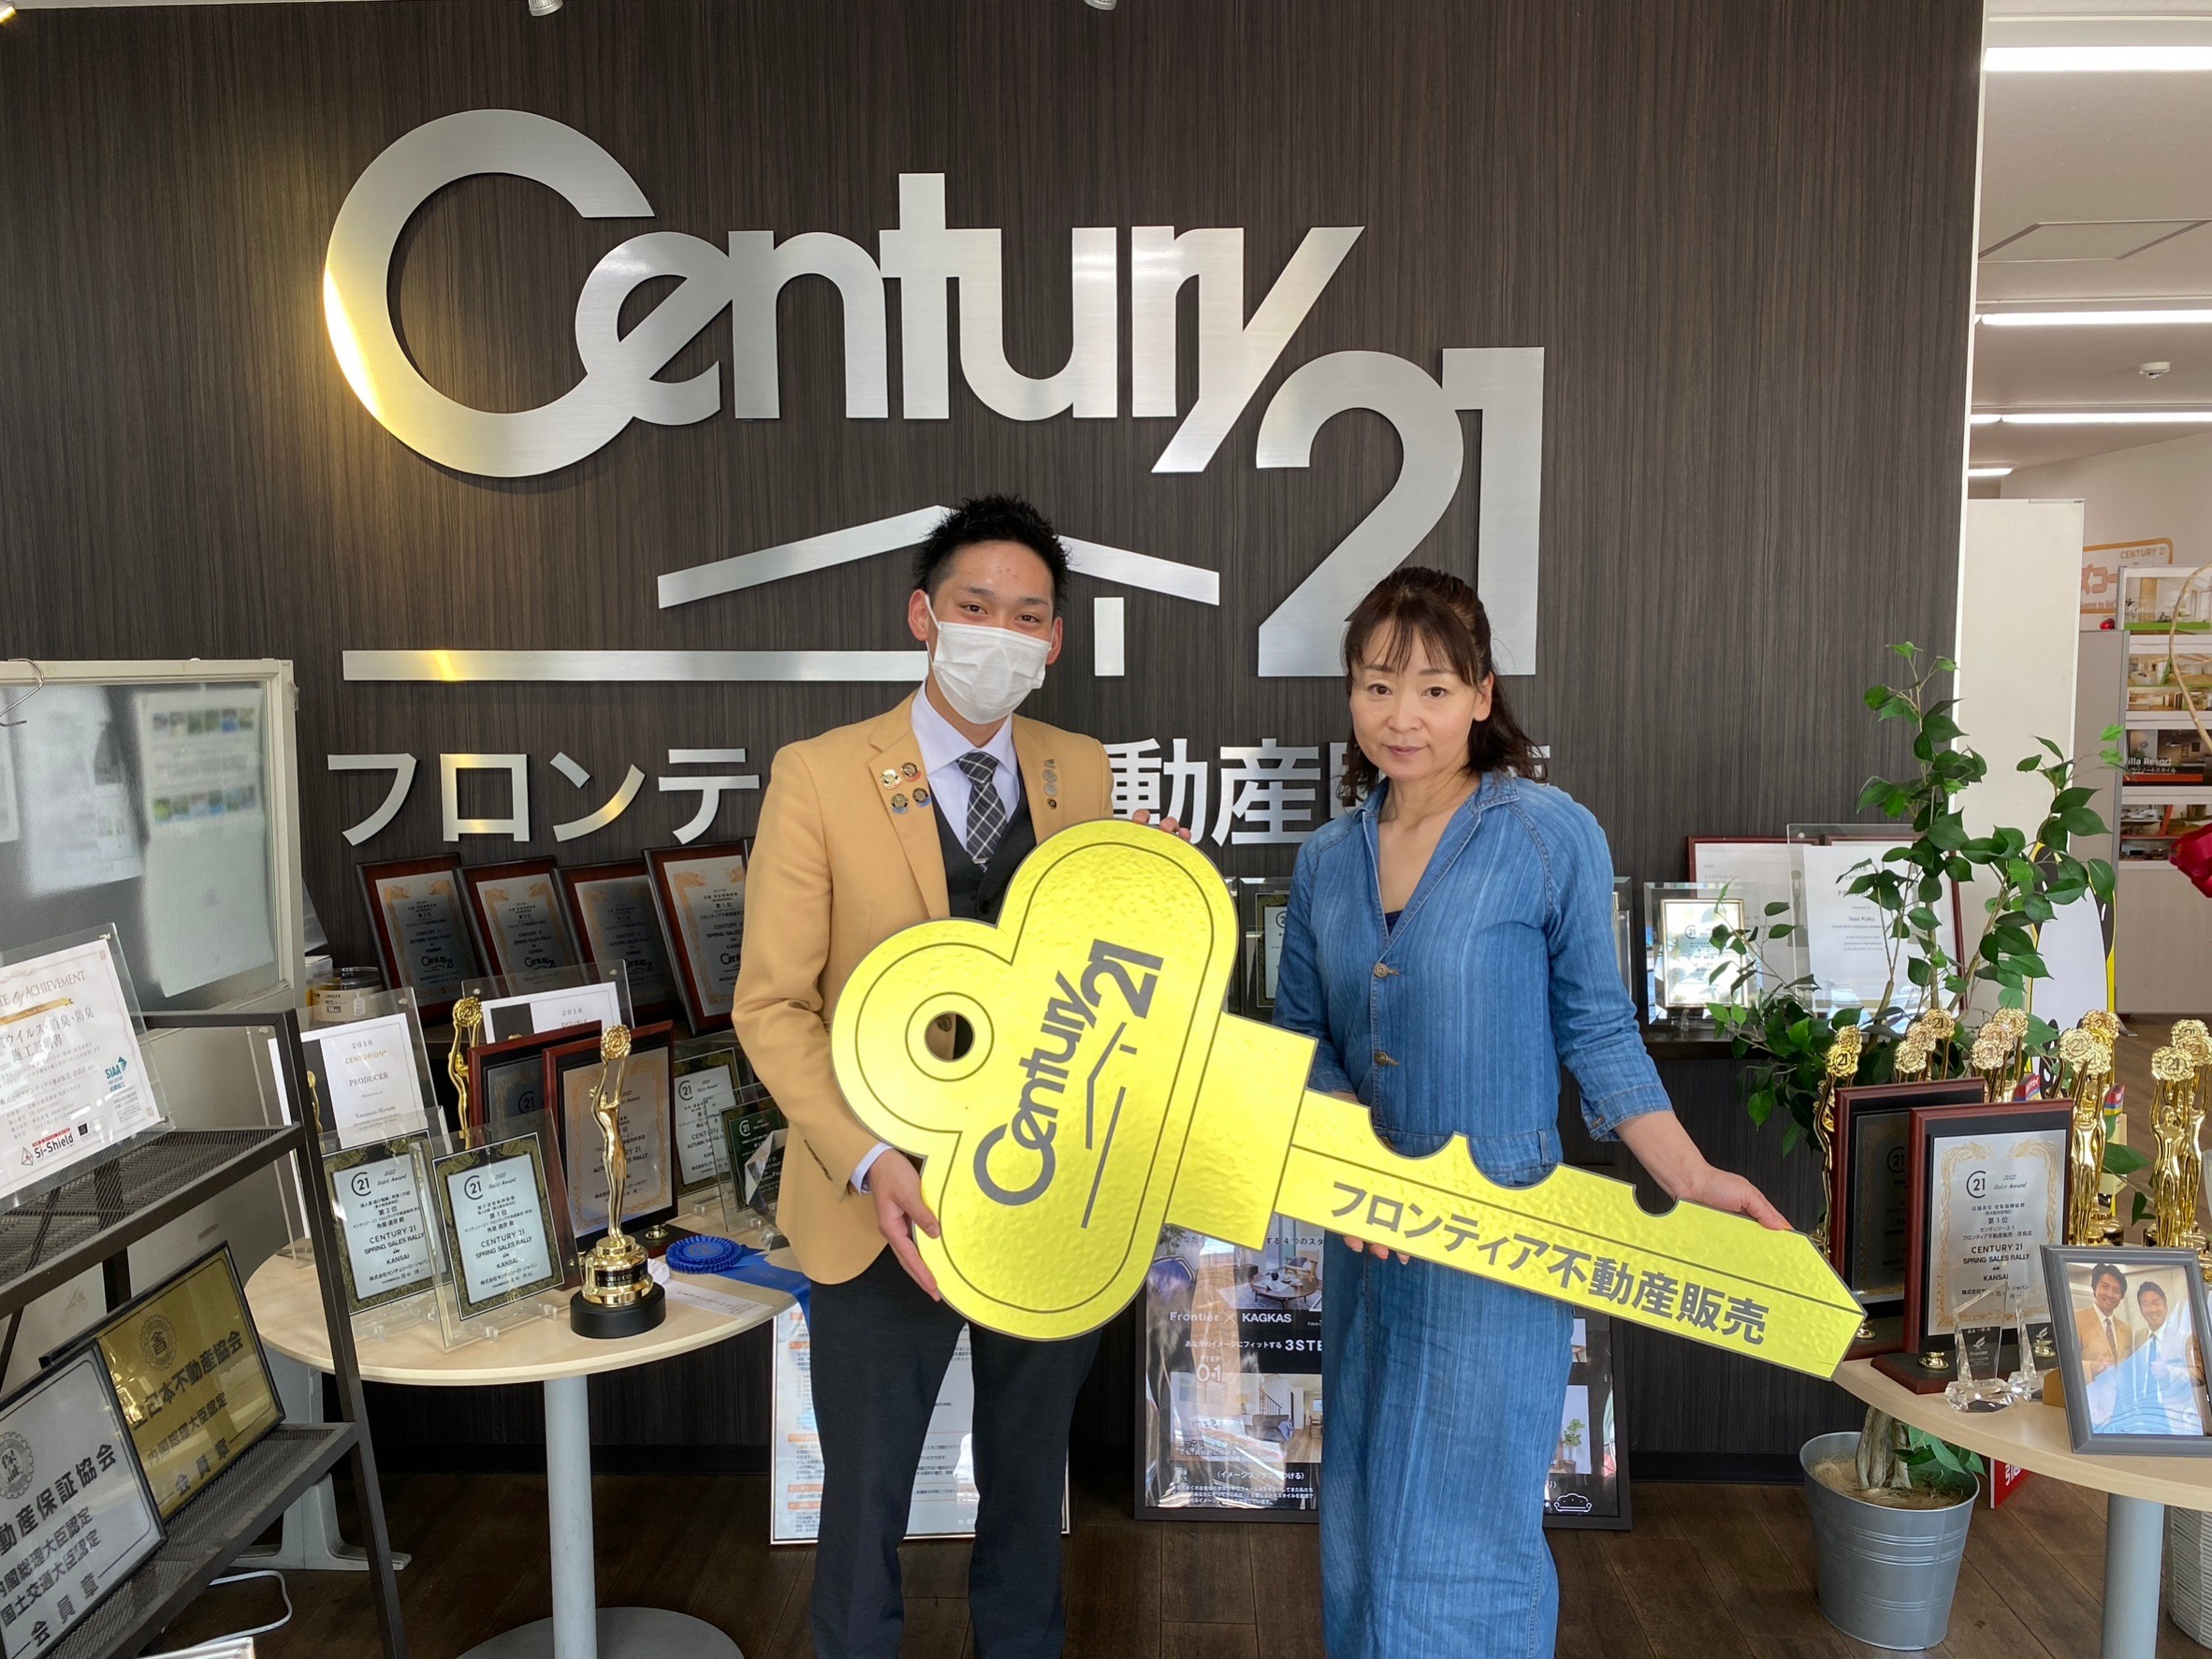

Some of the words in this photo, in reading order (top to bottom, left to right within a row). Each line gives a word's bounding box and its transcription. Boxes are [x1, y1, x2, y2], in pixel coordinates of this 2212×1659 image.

[324, 109, 1364, 478] Century
[1256, 347, 1544, 677] 21
[2120, 548, 2157, 559] CENTURY
[2128, 756, 2142, 765] illa
[2144, 757, 2172, 766] Resort
[25, 970, 86, 997] ACHIEVEMENT
[561, 1007, 583, 1016] 2016
[1933, 1018, 1944, 1029] 21
[352, 1039, 373, 1050] 2016
[614, 1035, 623, 1048] 21
[2071, 1038, 2086, 1051] 21
[1837, 1053, 1848, 1066] 21
[2167, 1056, 2180, 1070] 21
[105, 1064, 121, 1079] SIAA
[973, 969, 1098, 1206] Century
[1080, 938, 1164, 1019] 21
[349, 1071, 389, 1087] PRODUCER
[34, 1132, 74, 1159] Si-Shield
[633, 1153, 648, 1163] RALLY
[369, 1226, 407, 1244] CENTURY
[409, 1224, 417, 1233] 21
[480, 1231, 517, 1248] CENTURY
[517, 1228, 526, 1236] 21
[364, 1243, 386, 1255] SPRING
[387, 1237, 407, 1247] SALES
[407, 1231, 426, 1242] RALLY
[475, 1247, 497, 1259] SPRING
[498, 1242, 516, 1252] SALES
[516, 1235, 532, 1246] RALLY
[1971, 1243, 2014, 1254] CENTURY
[2016, 1243, 2023, 1251] 21
[386, 1253, 410, 1265] KANSAI
[1331, 1181, 1769, 1346] フロンティア不動産販売
[1963, 1256, 1986, 1264] SPRING
[1988, 1254, 2009, 1262] SALES
[1983, 1273, 2009, 1282] KANSAI
[1170, 1312, 1219, 1322] Frontier
[1242, 1313, 1292, 1323] KAGKAS
[1185, 1340, 1282, 1349] あなたのイメージにフィットする
[1195, 1363, 1222, 1383] 01
